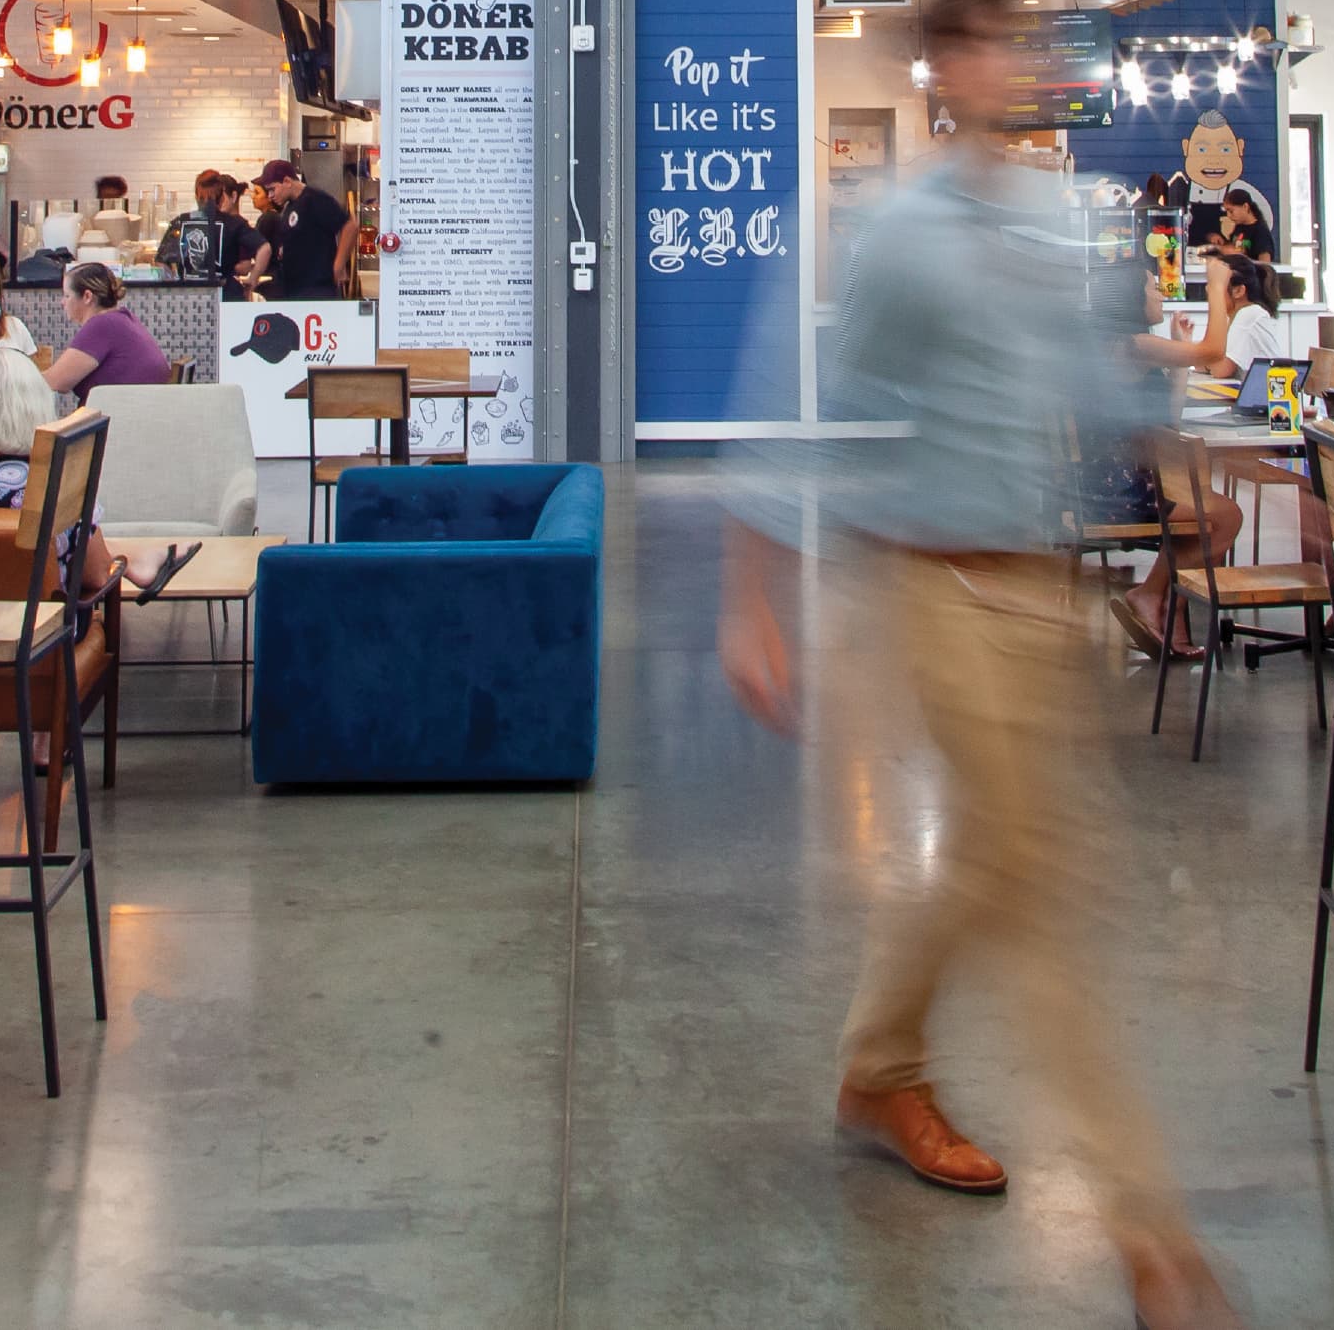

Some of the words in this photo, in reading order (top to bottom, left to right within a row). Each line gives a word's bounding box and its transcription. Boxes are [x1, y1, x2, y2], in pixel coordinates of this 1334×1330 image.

[404, 35, 530, 61] KEBAB
[664, 46, 720, 97] Pop
[729, 47, 766, 88] it
[653, 101, 719, 132] Like
[731, 101, 777, 132] it's
[660, 147, 772, 192] HOT
[303, 349, 336, 367] only
